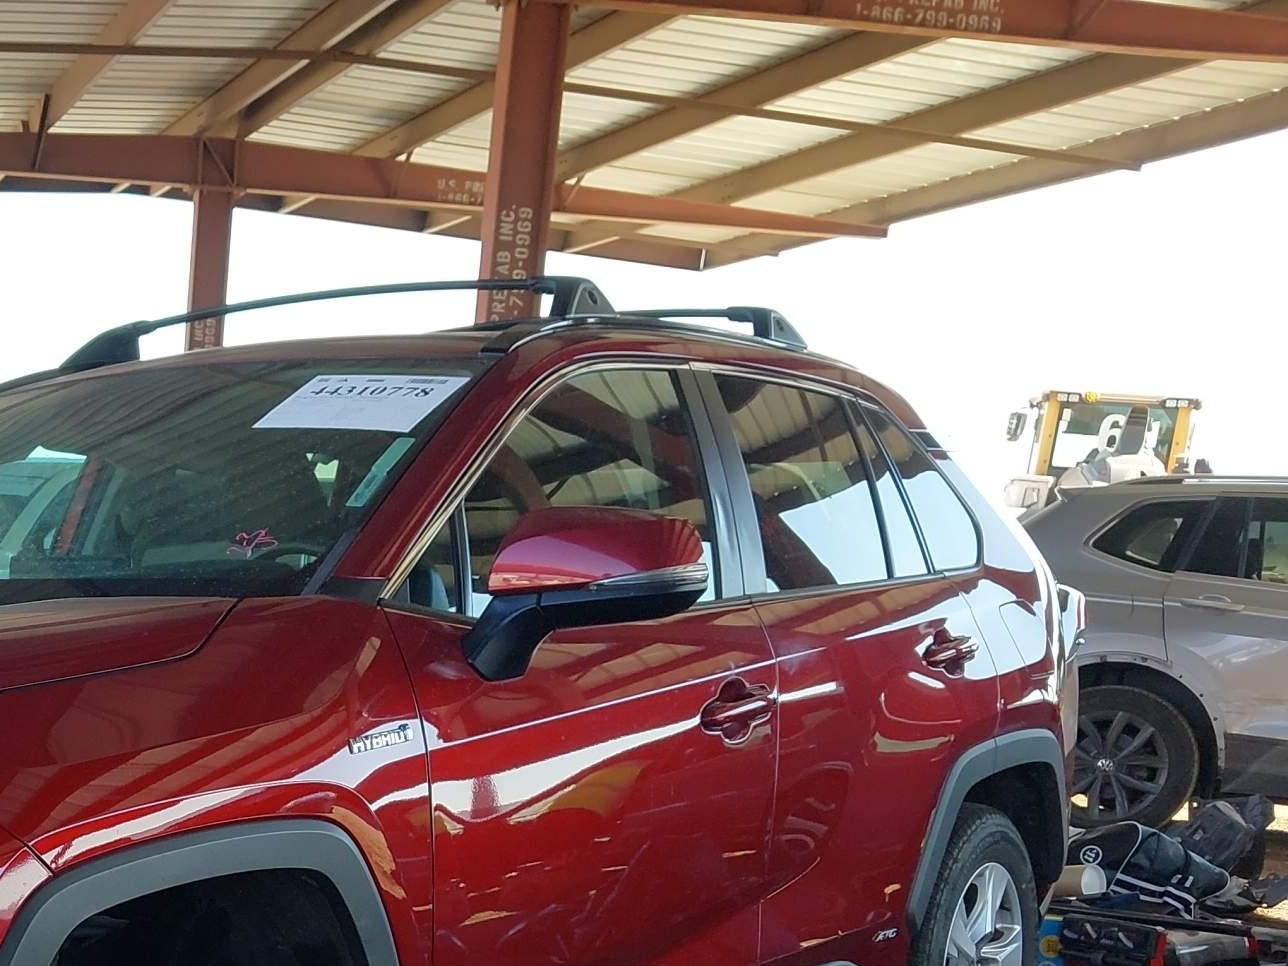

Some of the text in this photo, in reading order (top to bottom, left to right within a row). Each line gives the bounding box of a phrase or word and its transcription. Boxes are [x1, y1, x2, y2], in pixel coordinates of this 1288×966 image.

[855, 3, 1002, 33] 1-866-799-0969
[490, 204, 517, 322] PREAB INC.
[509, 207, 534, 316] -79-0969
[309, 384, 435, 398] 44310778
[349, 726, 413, 754] HYBRID
